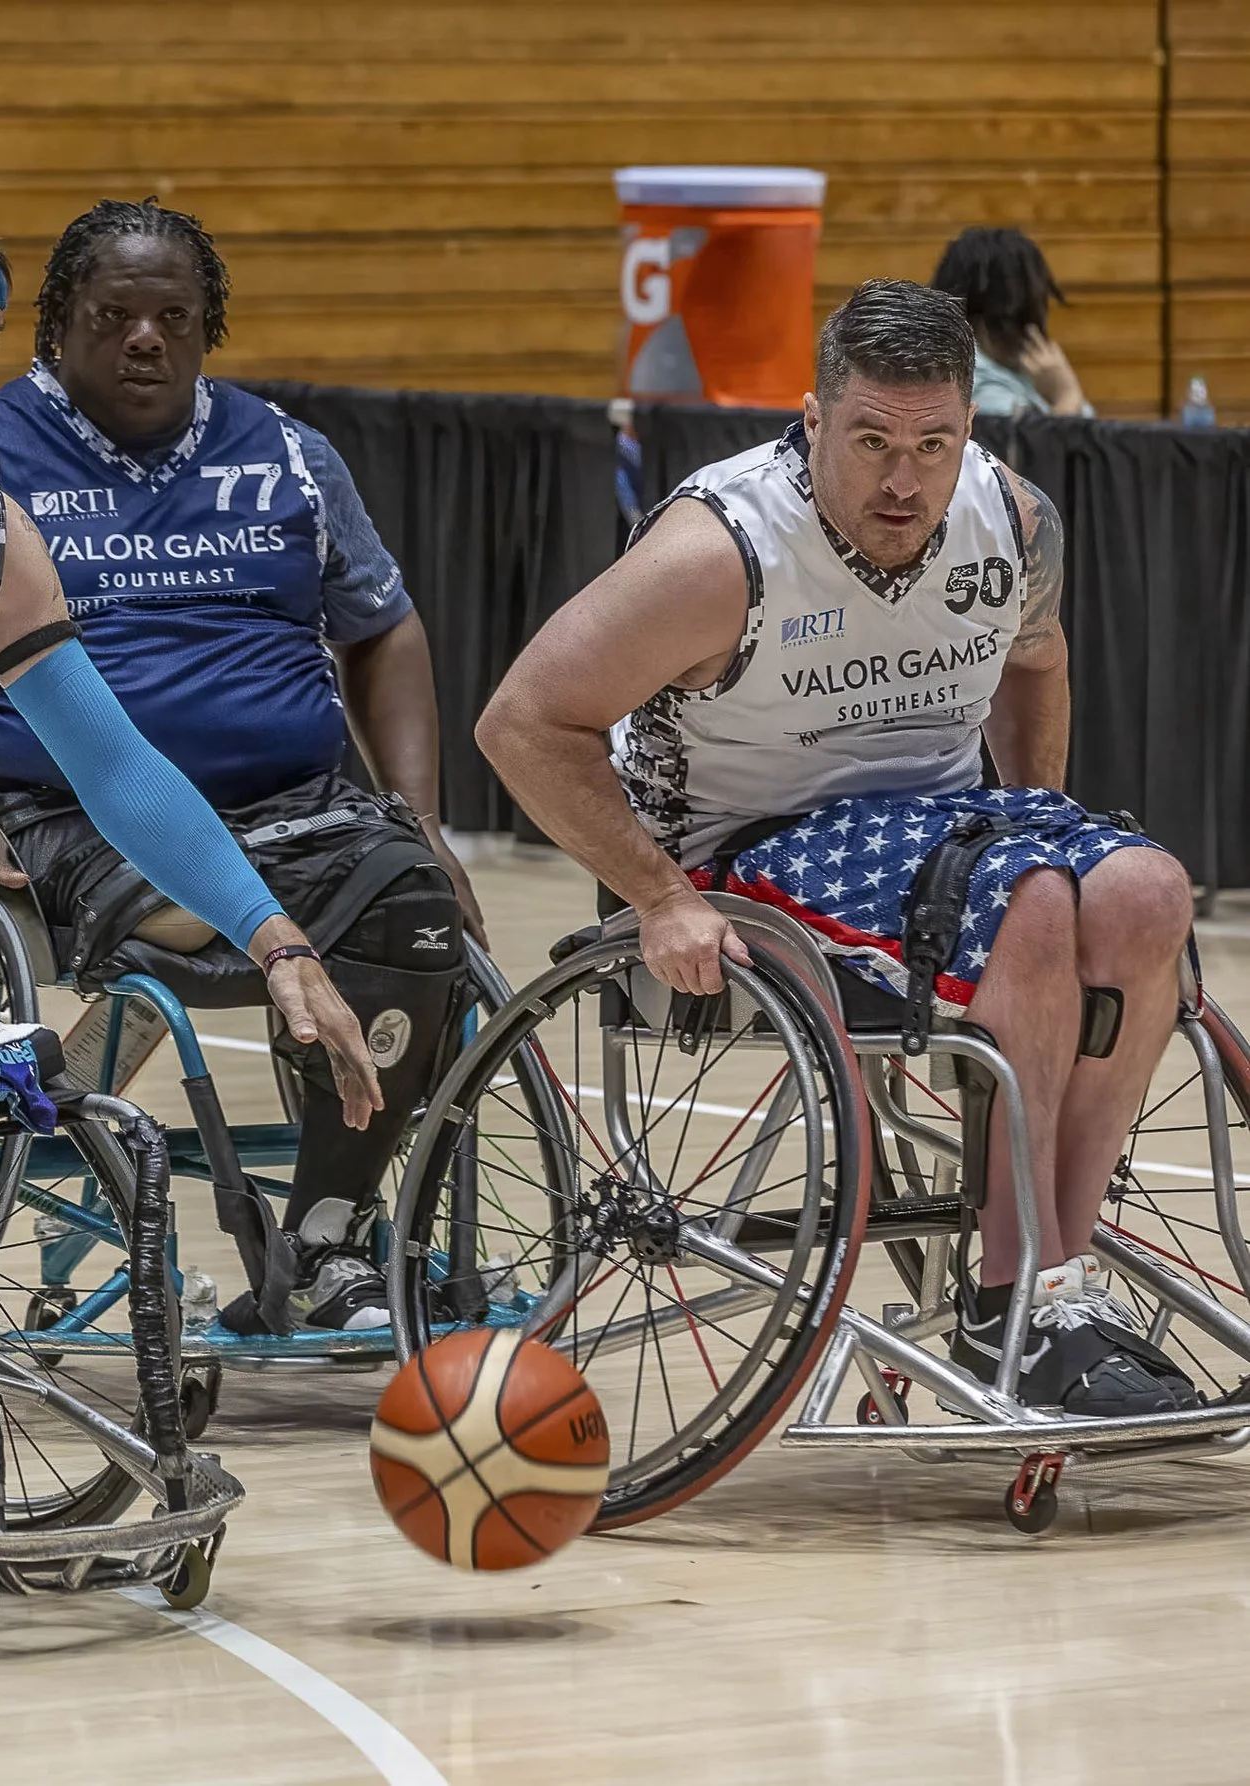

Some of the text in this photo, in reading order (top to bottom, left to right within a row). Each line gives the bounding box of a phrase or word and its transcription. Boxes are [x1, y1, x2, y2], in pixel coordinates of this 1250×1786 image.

[621, 238, 671, 325] G
[59, 488, 118, 514] RTI
[200, 463, 282, 511] 77
[164, 525, 286, 560] GAMES
[98, 567, 236, 589] SOUTHEAST
[944, 556, 1014, 615] 50
[800, 607, 846, 638] RTI
[781, 628, 1000, 698] VALOR GAMES
[837, 683, 961, 722] SOUTHEAST
